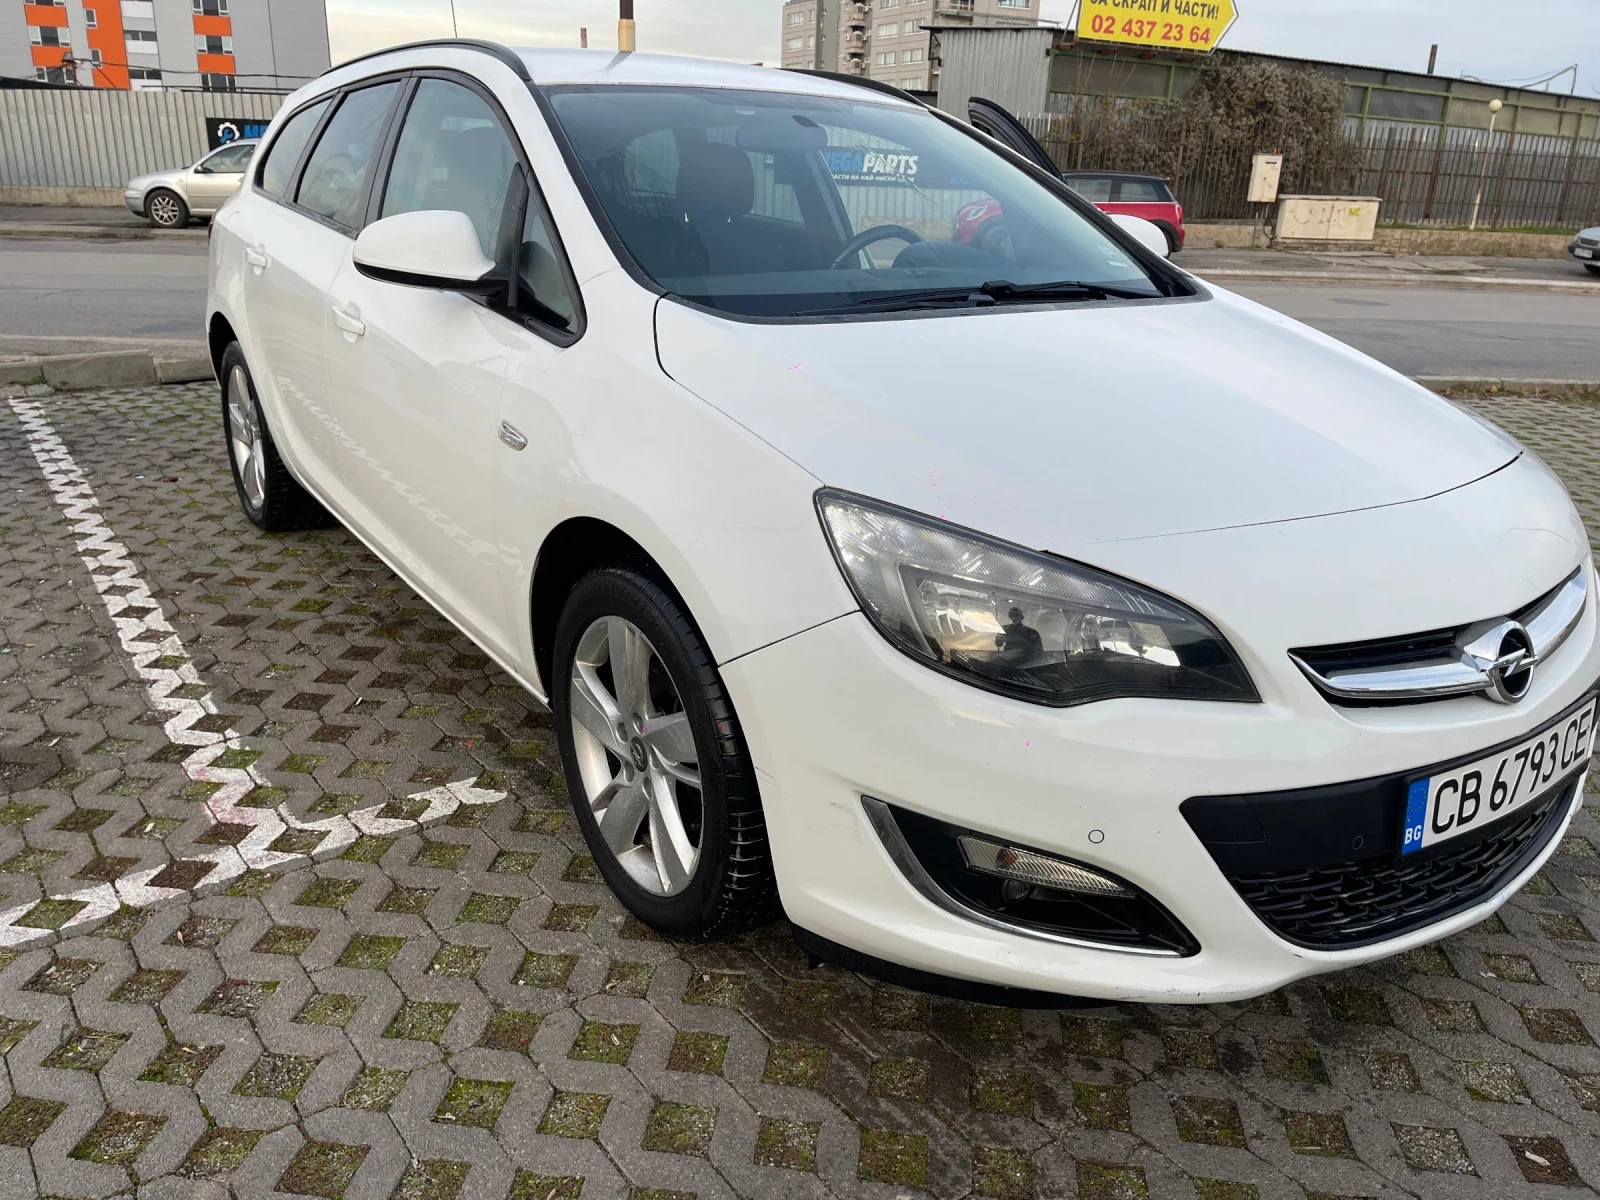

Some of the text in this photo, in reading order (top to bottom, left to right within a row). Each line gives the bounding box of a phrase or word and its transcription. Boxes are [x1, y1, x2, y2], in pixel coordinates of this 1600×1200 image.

[1112, 0, 1157, 12] СКРАП
[1160, 0, 1170, 13] И
[1174, 2, 1219, 20] ЧАСТИ!
[1091, 14, 1211, 45] 02 437 23 64
[1431, 707, 1592, 834] CB 6793 CE
[1404, 824, 1422, 845] BG
